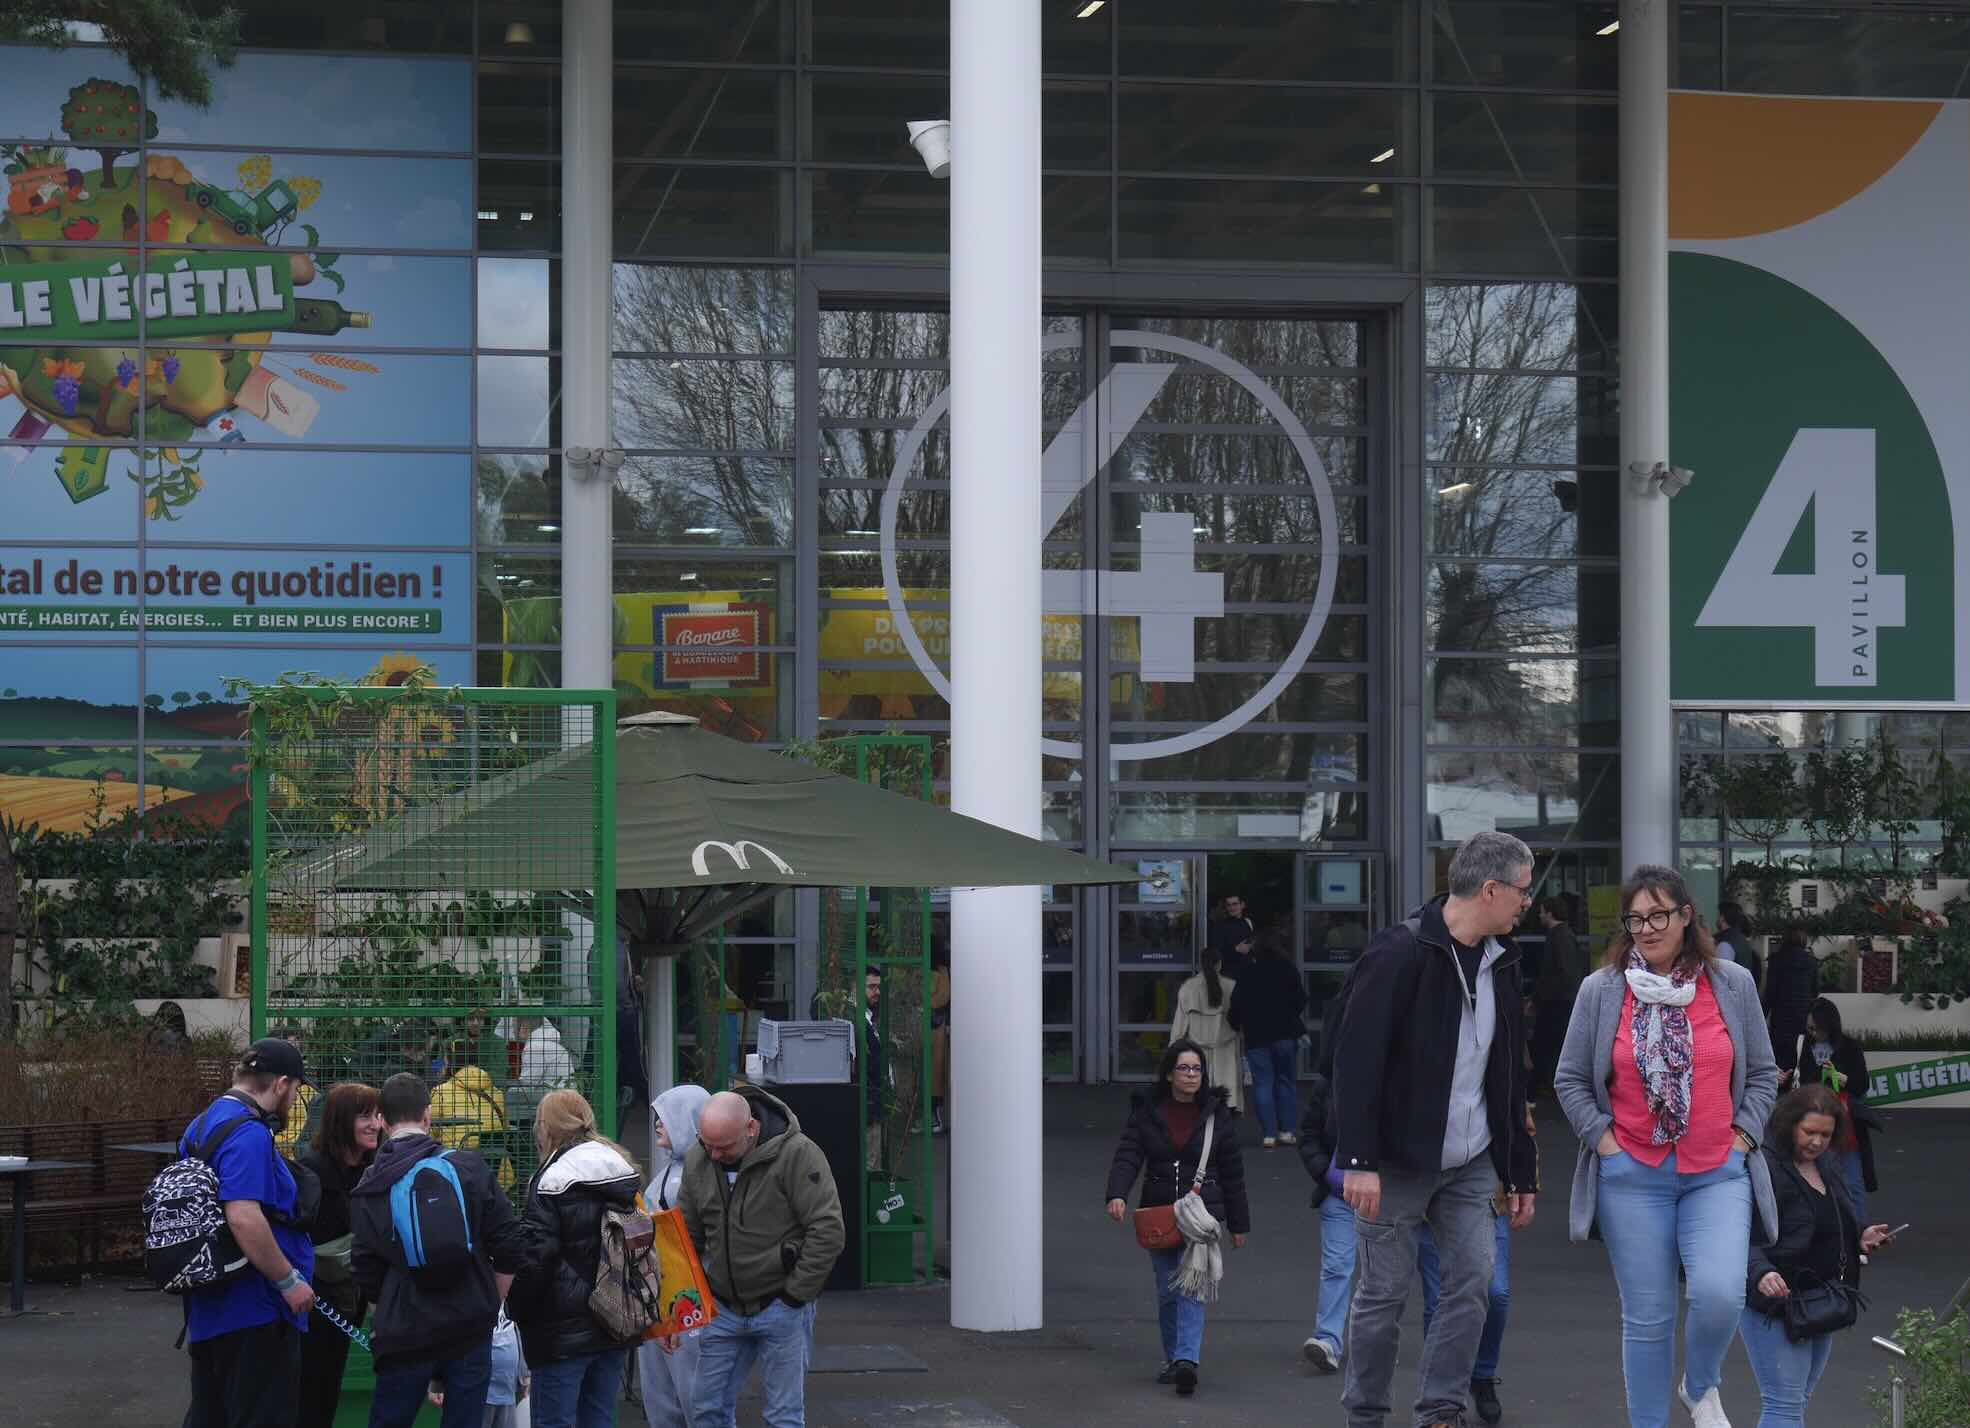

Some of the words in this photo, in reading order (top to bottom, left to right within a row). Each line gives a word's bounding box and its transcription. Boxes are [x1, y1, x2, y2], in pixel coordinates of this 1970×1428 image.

[0, 280, 52, 327] LE
[69, 257, 284, 324] VÉGÉTAL
[54, 559, 103, 595] de
[113, 564, 221, 596] notre
[231, 561, 422, 605] quotidien
[432, 564, 442, 598] !
[1693, 427, 1906, 687] 4
[39, 613, 115, 629] HABITAT,
[120, 610, 222, 627] ÉNERGIES...
[233, 614, 254, 626] ET
[258, 614, 298, 627] BIEN
[304, 614, 347, 627] PLUS
[352, 615, 419, 628] ENCORE
[1851, 527, 1870, 678] PAVILLON
[675, 627, 745, 646] Banane
